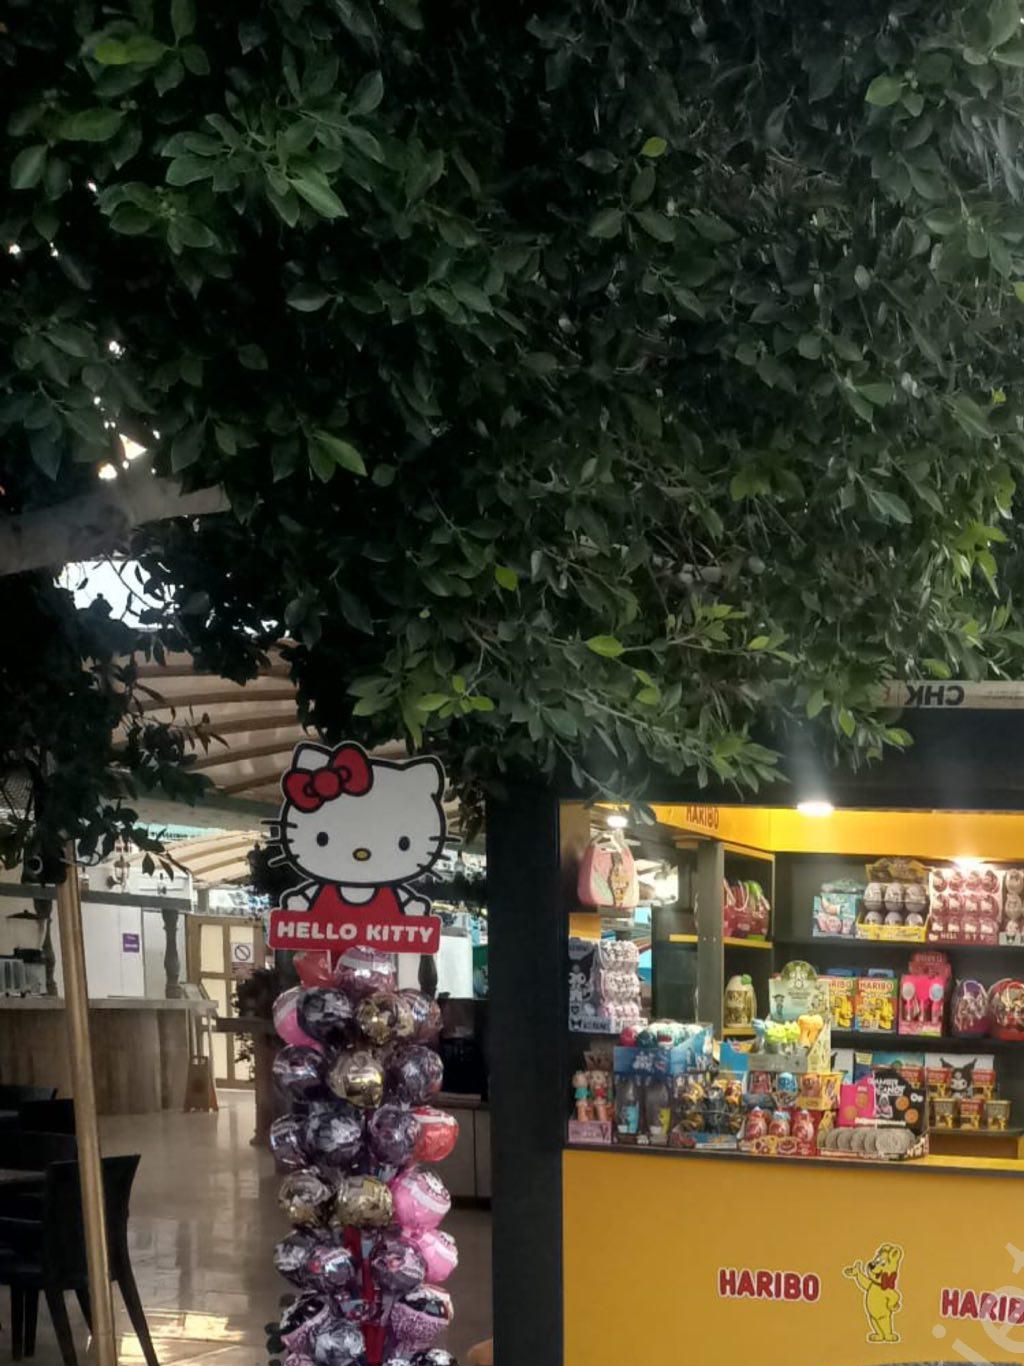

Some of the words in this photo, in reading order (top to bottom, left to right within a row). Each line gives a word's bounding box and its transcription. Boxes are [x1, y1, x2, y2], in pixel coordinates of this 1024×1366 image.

[904, 685, 965, 706] CHK
[277, 921, 358, 941] HELLO
[366, 924, 433, 943] KITTY
[719, 1269, 820, 1301] HARIBO
